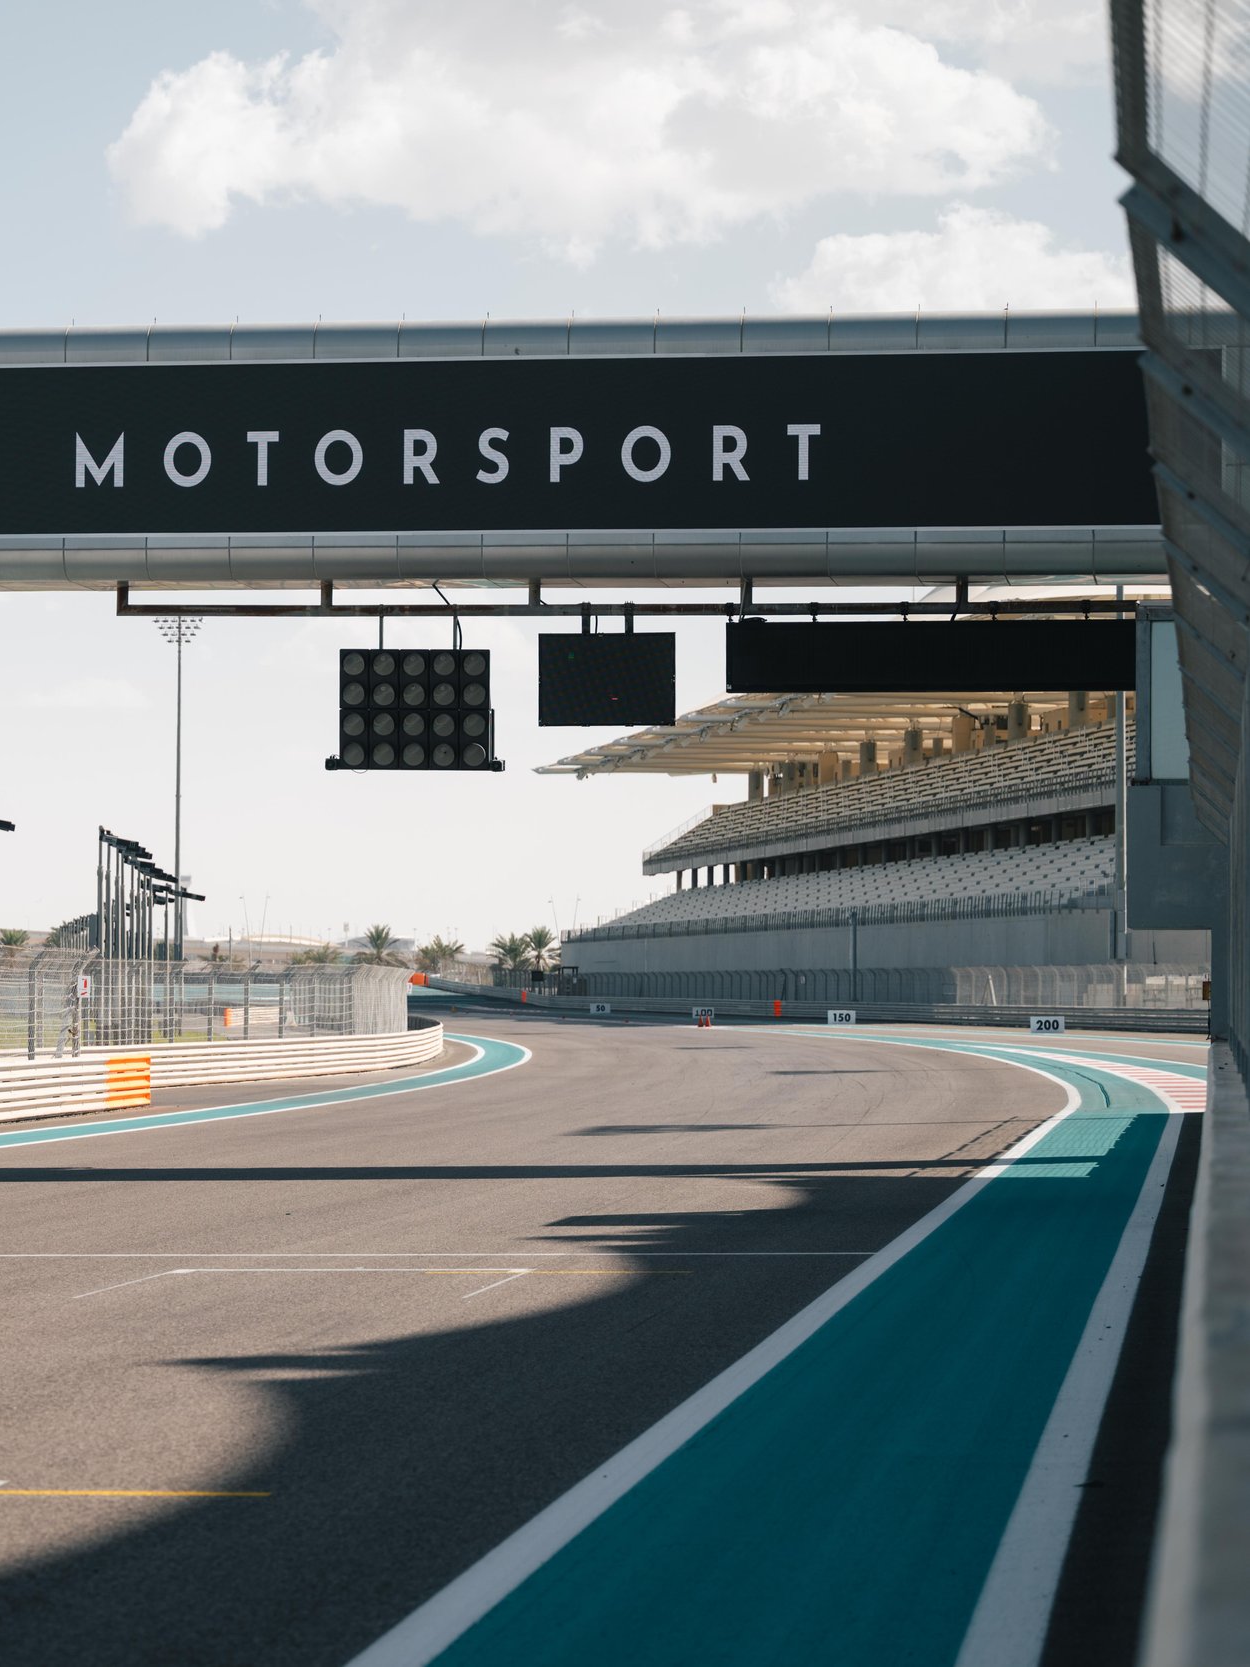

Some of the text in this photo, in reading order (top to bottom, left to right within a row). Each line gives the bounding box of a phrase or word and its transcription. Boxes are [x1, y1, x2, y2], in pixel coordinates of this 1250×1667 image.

[75, 423, 821, 488] MOTORSPORT
[596, 1004, 606, 1012] 50
[832, 1012, 852, 1023] 150
[1035, 1019, 1061, 1031] 200
